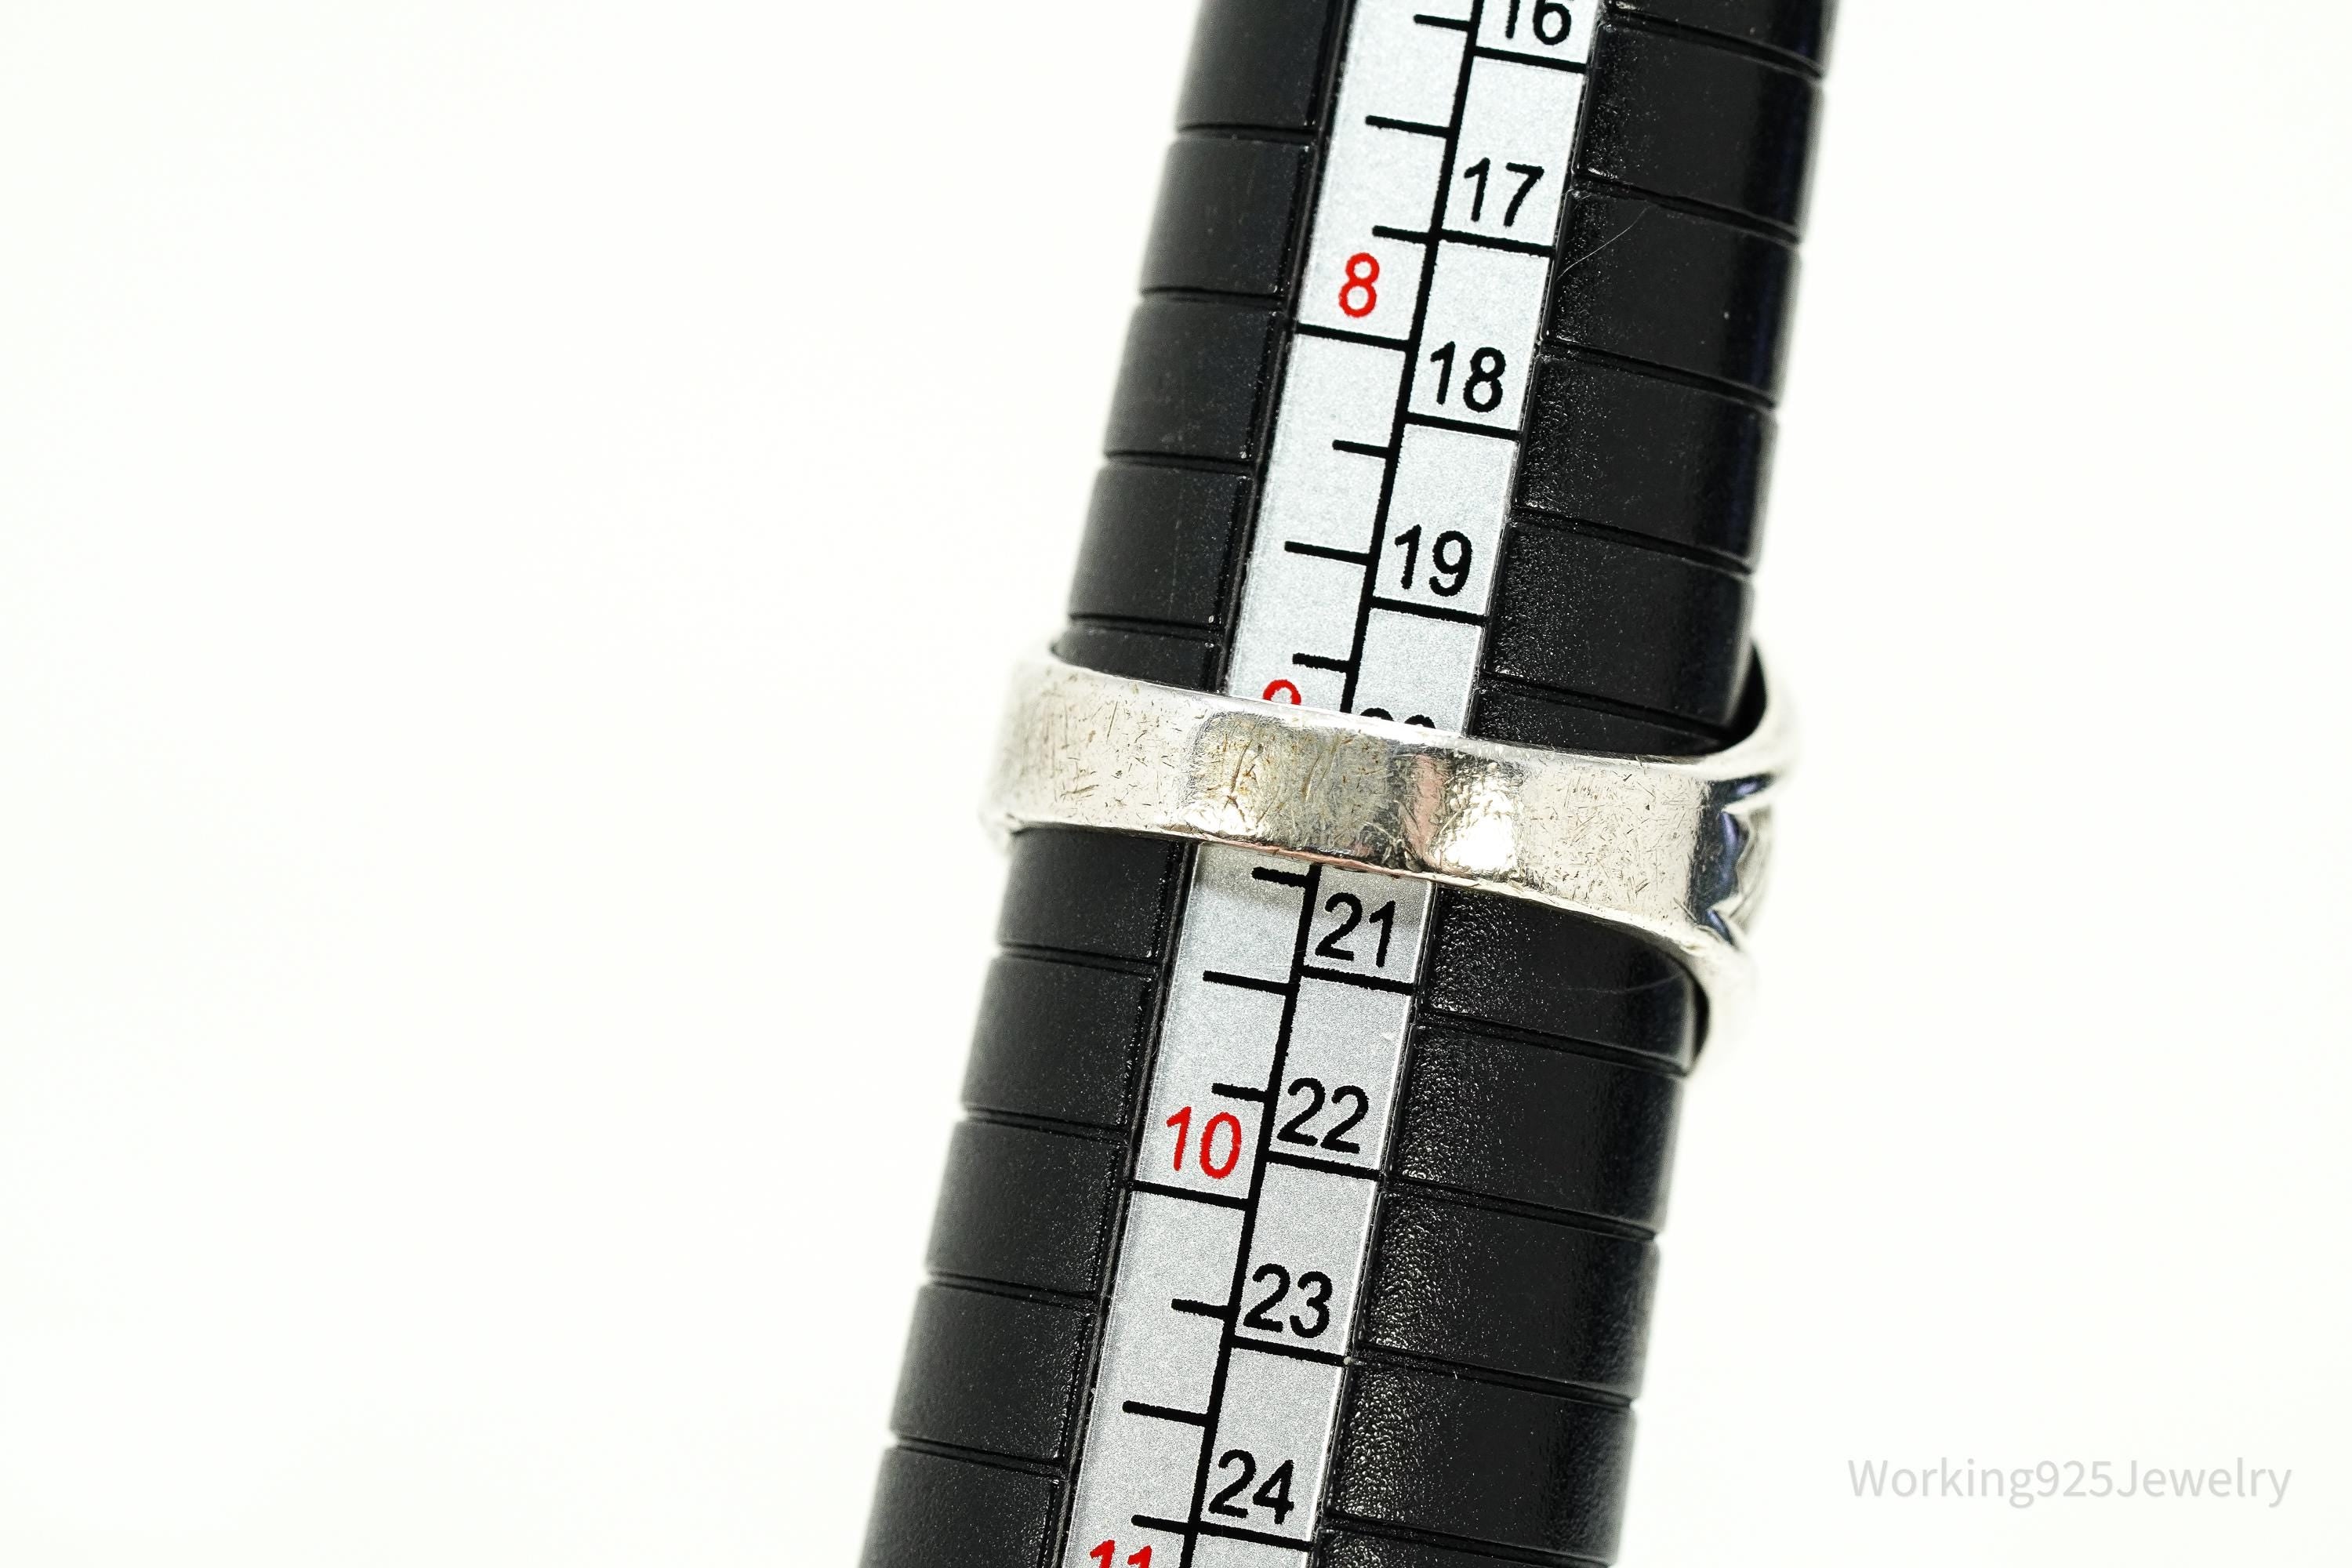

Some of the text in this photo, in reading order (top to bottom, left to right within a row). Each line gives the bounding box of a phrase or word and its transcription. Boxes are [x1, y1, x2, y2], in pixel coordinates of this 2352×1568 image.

[1504, 0, 1572, 46] 16
[1464, 157, 1544, 227] 17
[1338, 252, 1381, 319] 8
[1430, 340, 1507, 413] 18
[1394, 524, 1473, 597] 19
[1314, 891, 1396, 969] 21
[1166, 1105, 1243, 1180] 10
[1276, 1076, 1370, 1155] 22
[1242, 1262, 1334, 1339] 23
[1207, 1448, 1295, 1526] 24
